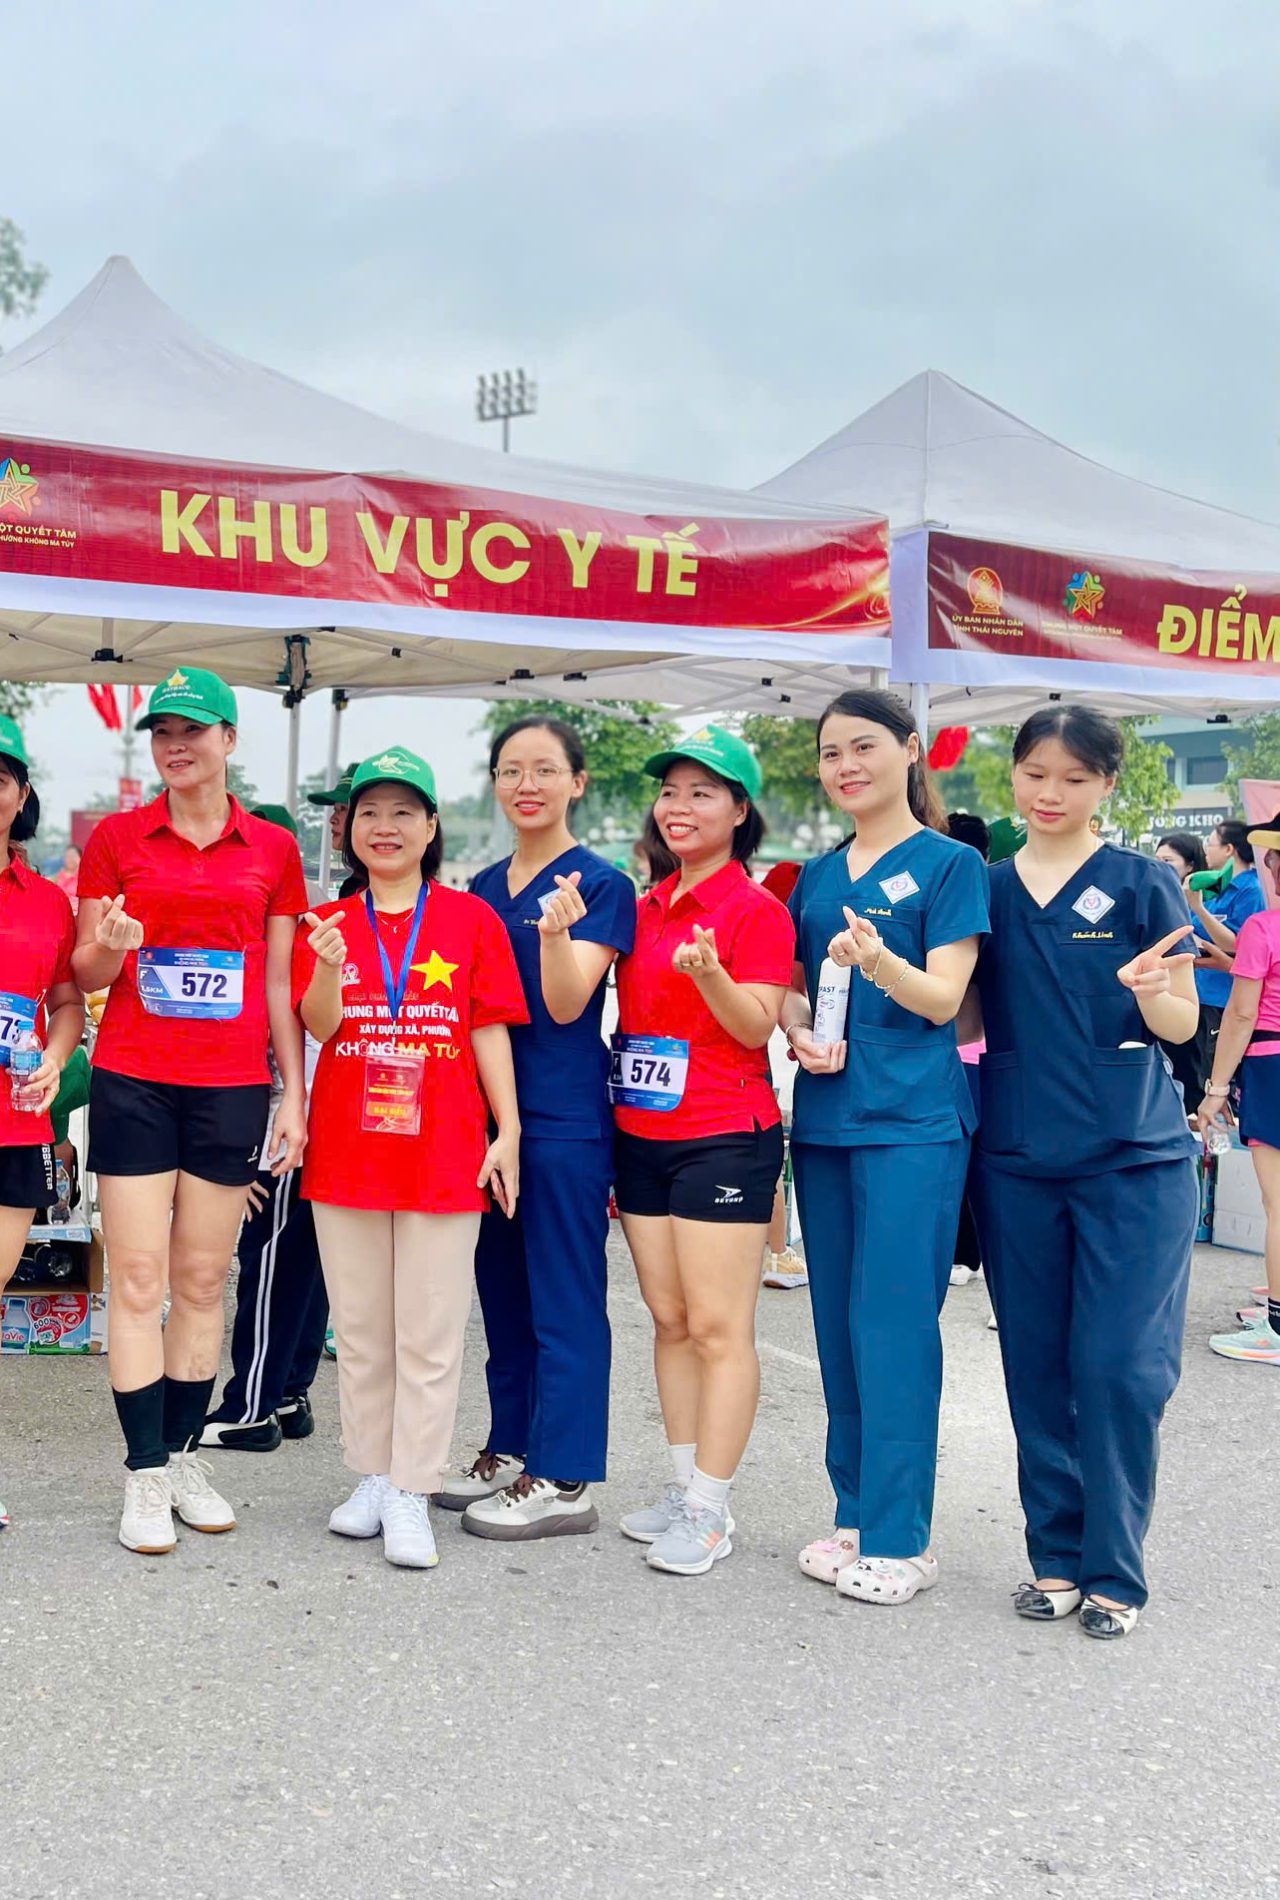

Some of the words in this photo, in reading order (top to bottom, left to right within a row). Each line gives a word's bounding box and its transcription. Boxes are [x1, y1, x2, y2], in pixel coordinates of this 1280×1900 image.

[15, 525, 52, 536] QUYẾT
[54, 529, 76, 539] TÂM
[160, 490, 328, 567] KHU
[356, 511, 531, 597] VỰC
[557, 529, 602, 588] Y
[626, 521, 700, 596] TẾ
[1157, 583, 1280, 663] ĐIỂM
[182, 972, 227, 998] 572
[342, 1005, 373, 1018] HUNG
[406, 1001, 444, 1019] QUYẾT
[398, 1042, 431, 1057] MA
[630, 1059, 671, 1087] 574
